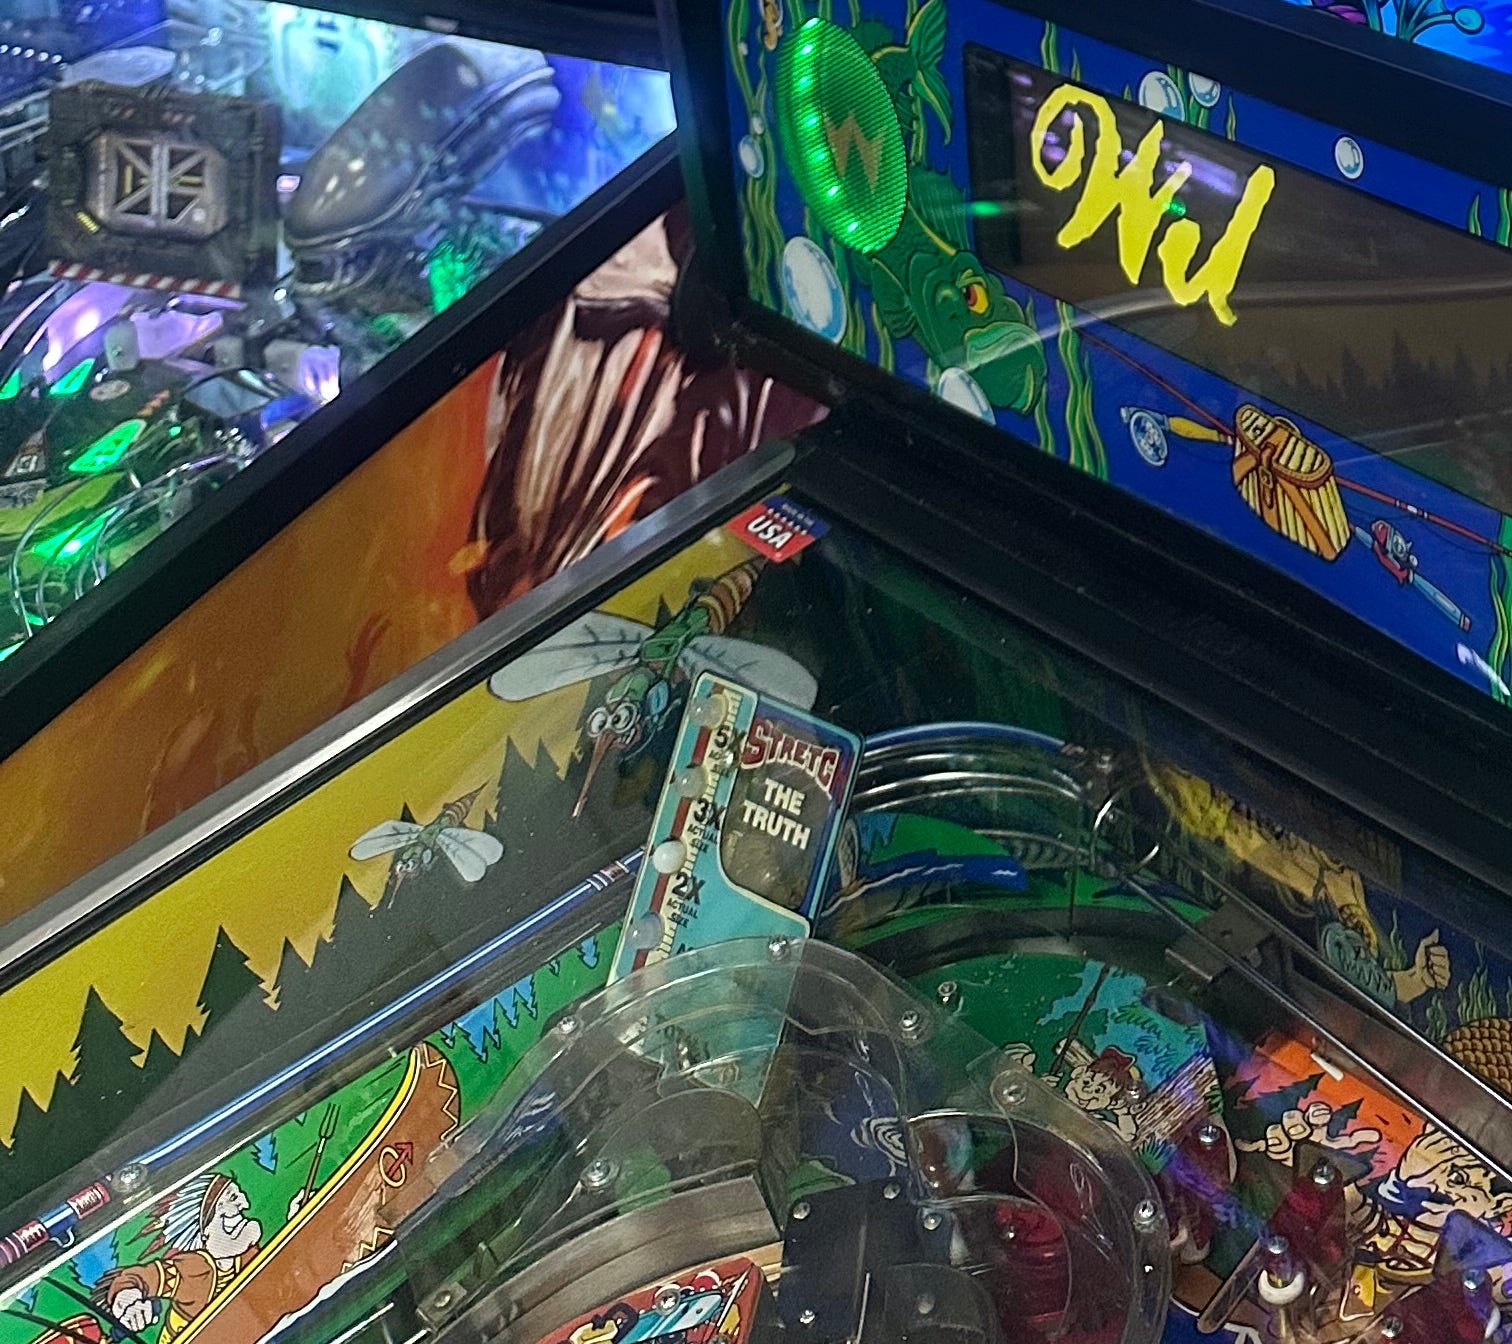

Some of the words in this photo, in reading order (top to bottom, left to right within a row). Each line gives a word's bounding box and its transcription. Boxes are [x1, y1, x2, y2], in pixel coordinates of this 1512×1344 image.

[747, 514, 794, 549] USA
[764, 777, 806, 816] THE
[694, 797, 726, 831] 3X
[743, 799, 812, 851] TRUTH
[671, 871, 706, 905] 2X
[667, 897, 699, 919] ACTUAL
